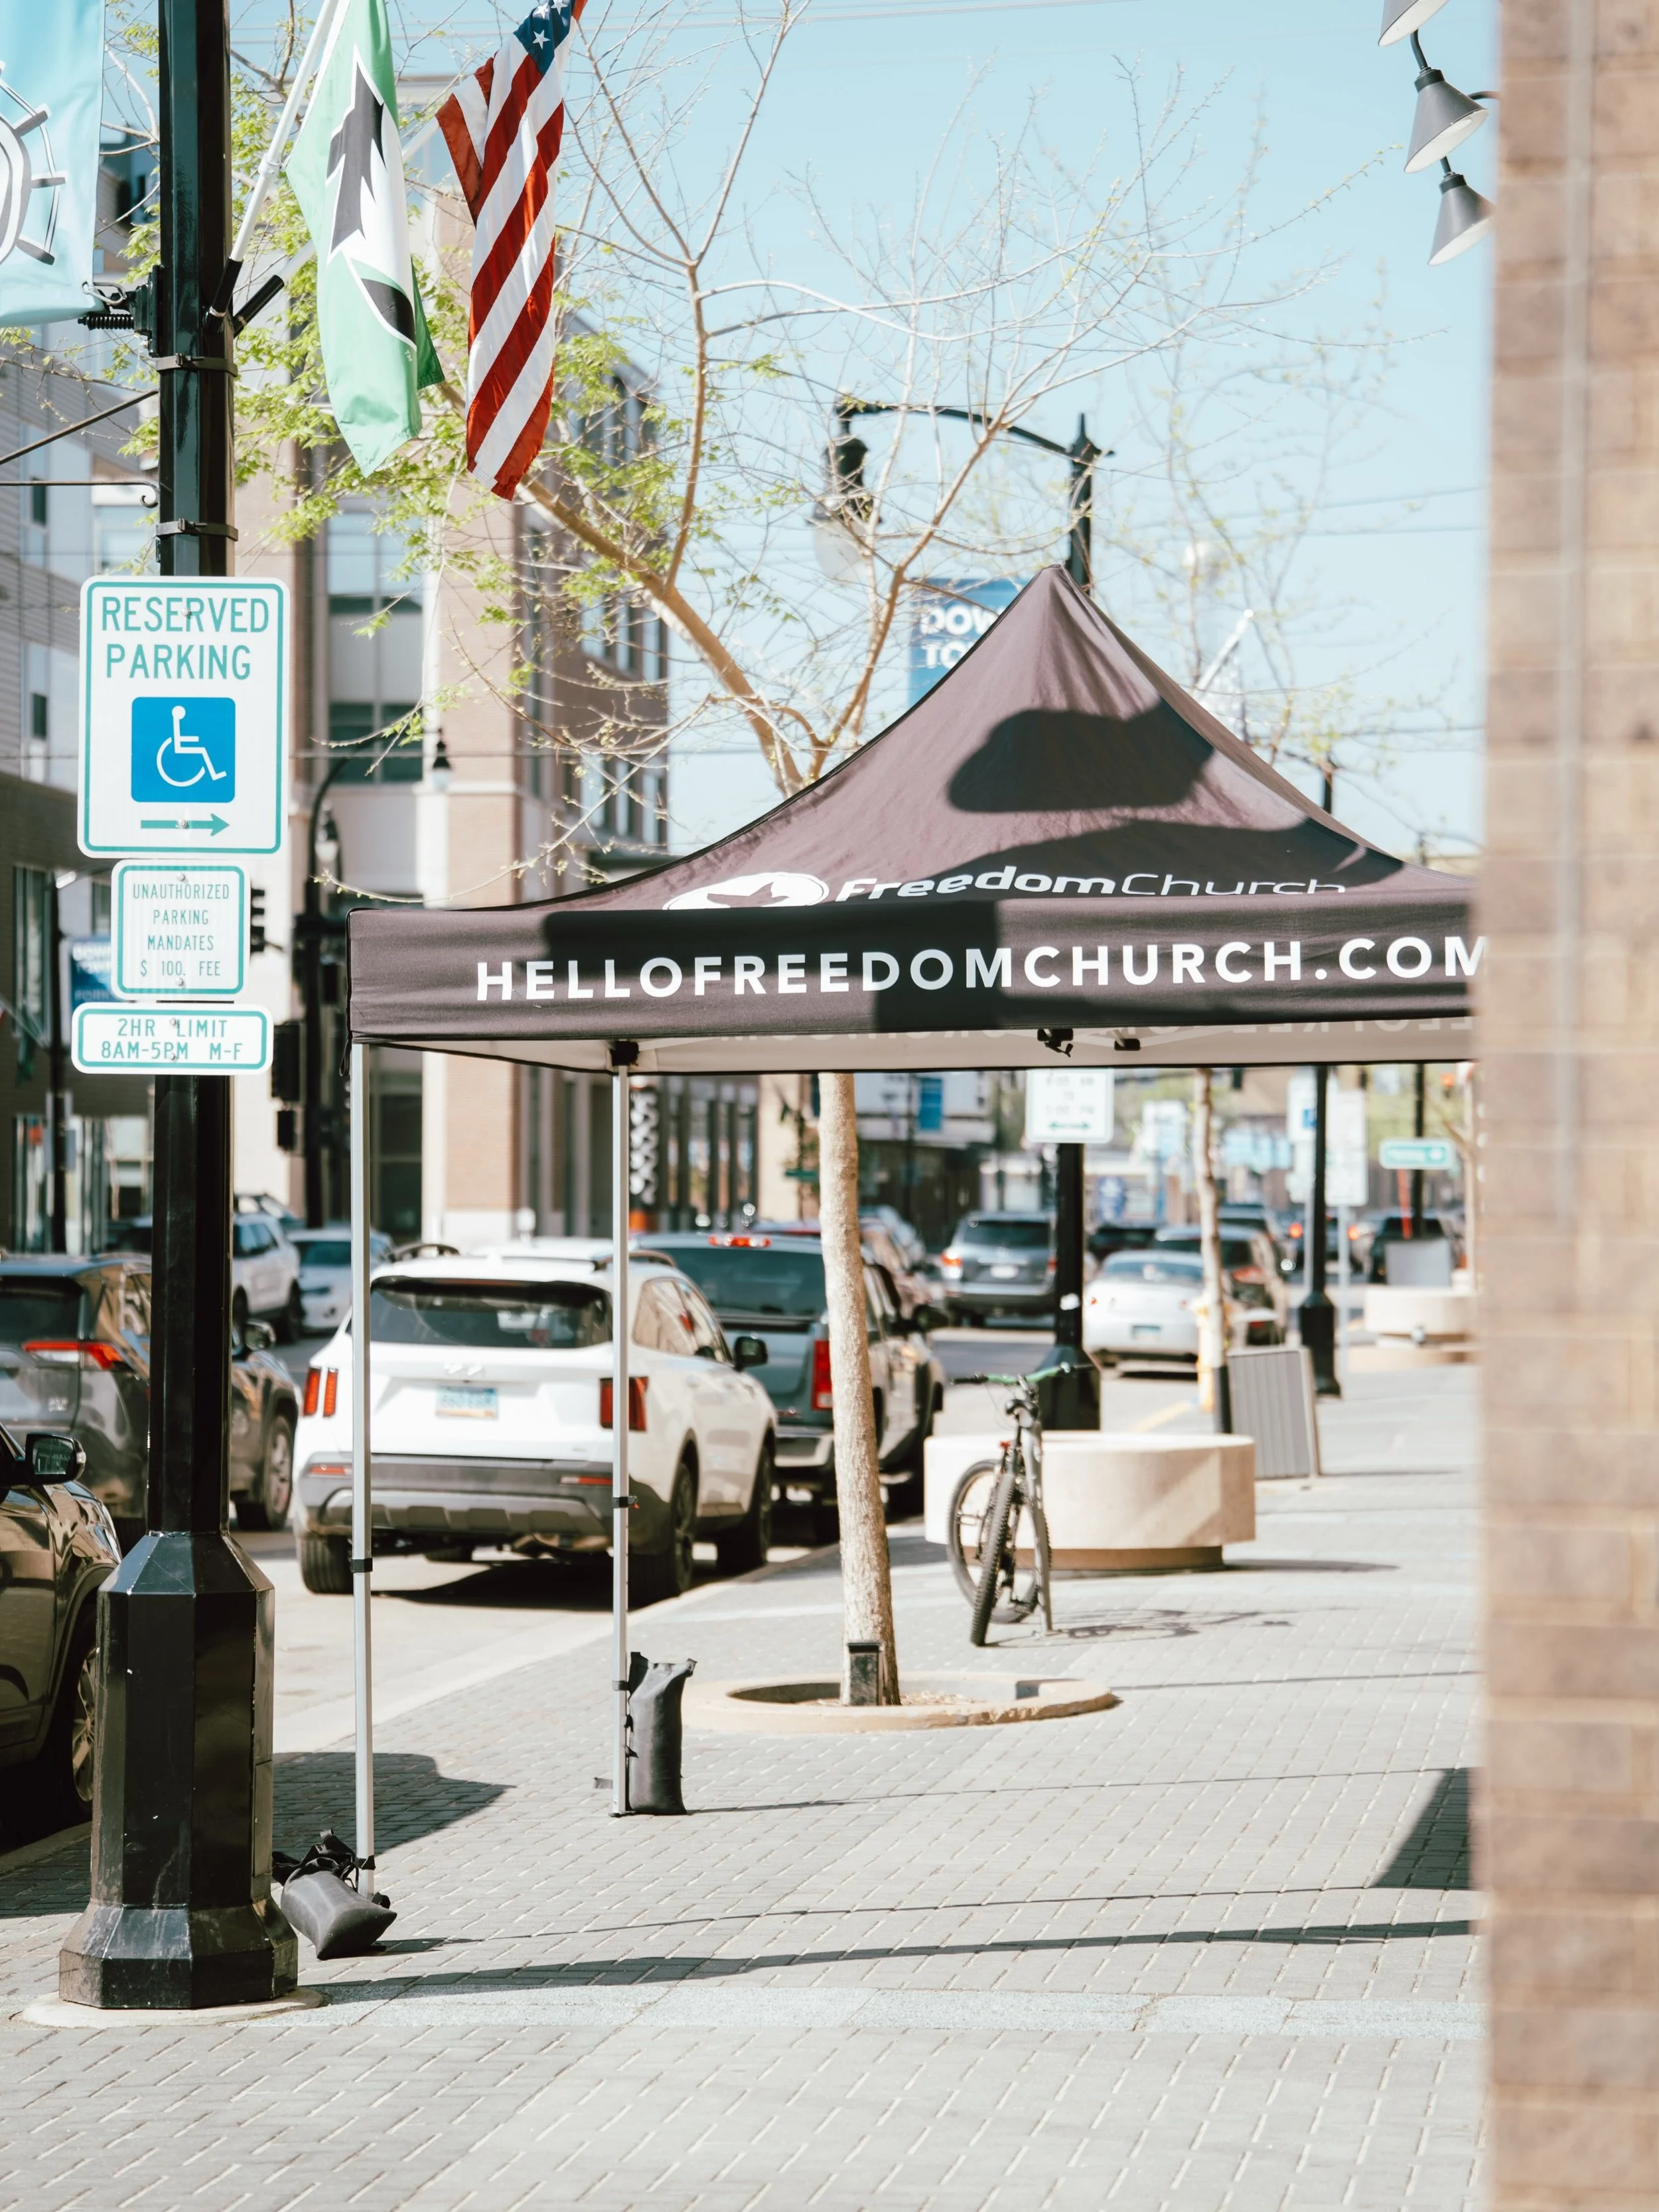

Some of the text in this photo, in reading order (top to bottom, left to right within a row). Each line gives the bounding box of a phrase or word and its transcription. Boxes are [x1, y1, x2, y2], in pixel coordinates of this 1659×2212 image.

[102, 597, 269, 633] RESERVED
[106, 644, 252, 680] PARKING
[921, 640, 975, 669] TO
[133, 883, 230, 899] UNAUTHORIZED
[835, 865, 1346, 902] FreedomChurch
[153, 909, 209, 924] PARKING
[147, 935, 214, 950] MANDATES
[140, 960, 221, 977] $ 100. FEE
[476, 936, 1488, 1001] HELLOFREEDOMCHURCH.COM
[117, 1018, 227, 1037] 2HR LIMIT
[101, 1041, 243, 1061] 8AM-5PM M-F
